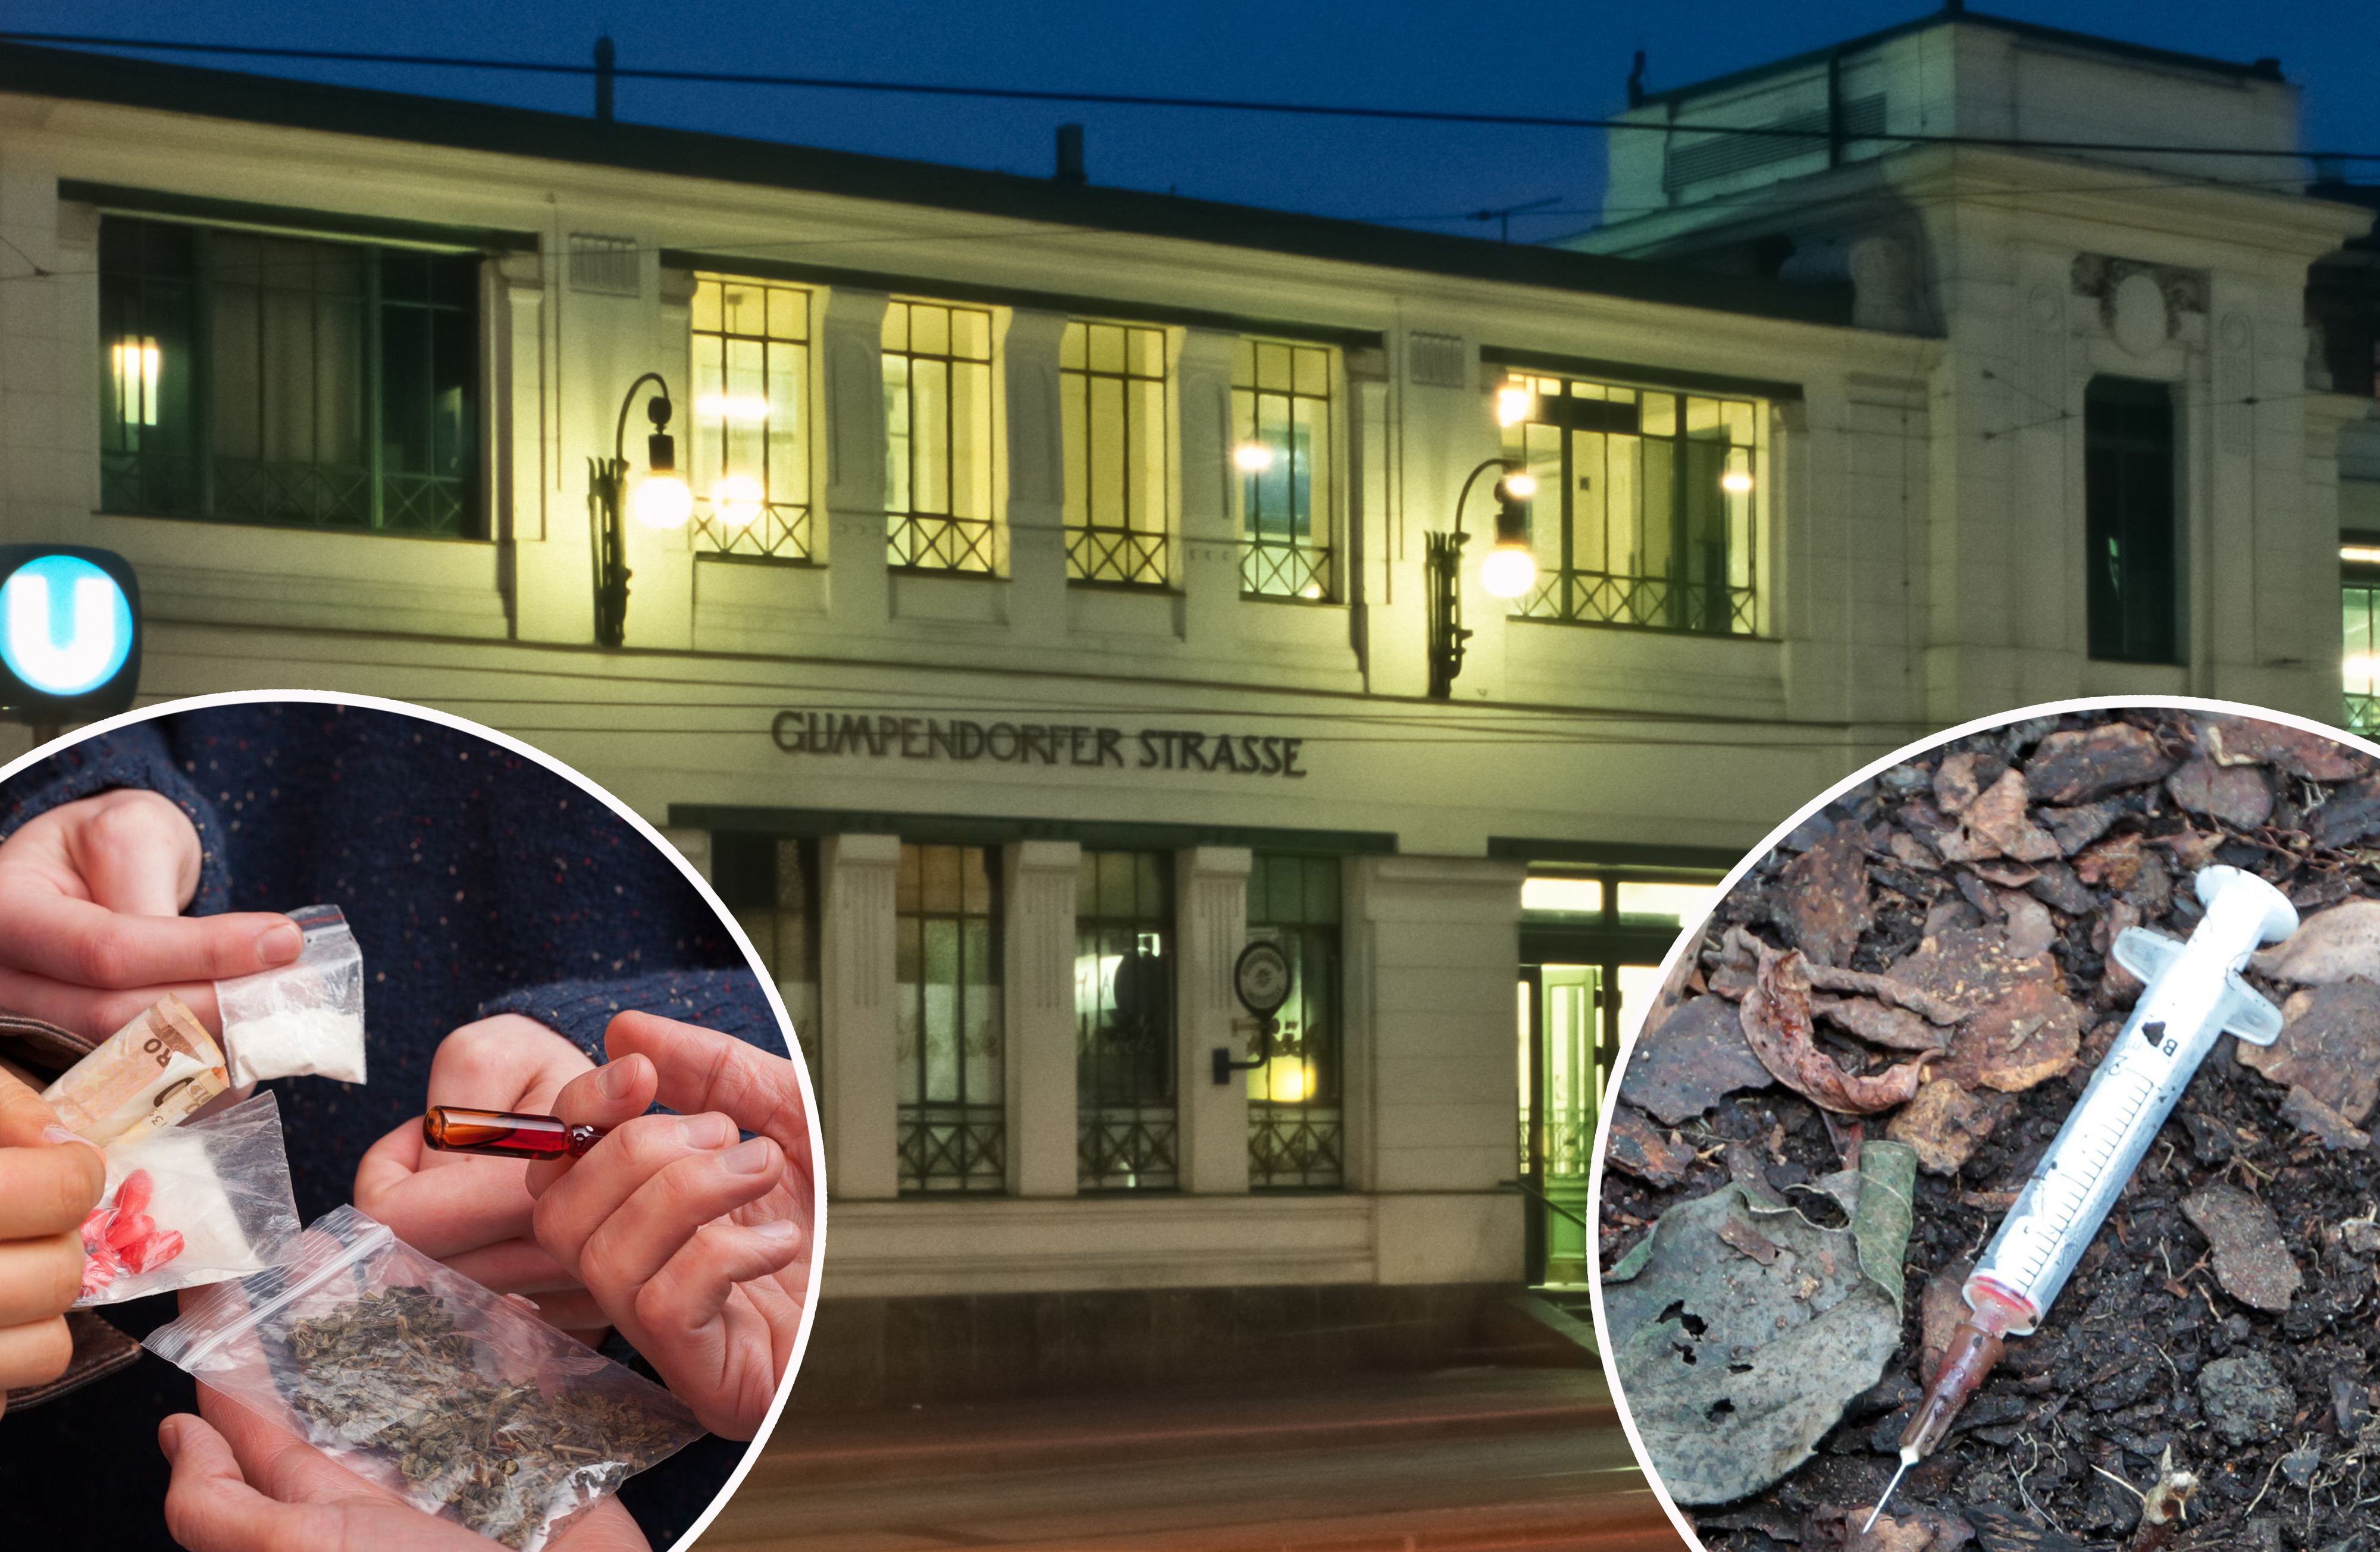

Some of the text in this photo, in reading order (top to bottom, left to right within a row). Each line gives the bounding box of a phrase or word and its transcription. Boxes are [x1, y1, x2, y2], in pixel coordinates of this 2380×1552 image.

[10, 574, 115, 689] U
[771, 710, 1308, 778] GUMPENDORFER STRASSE
